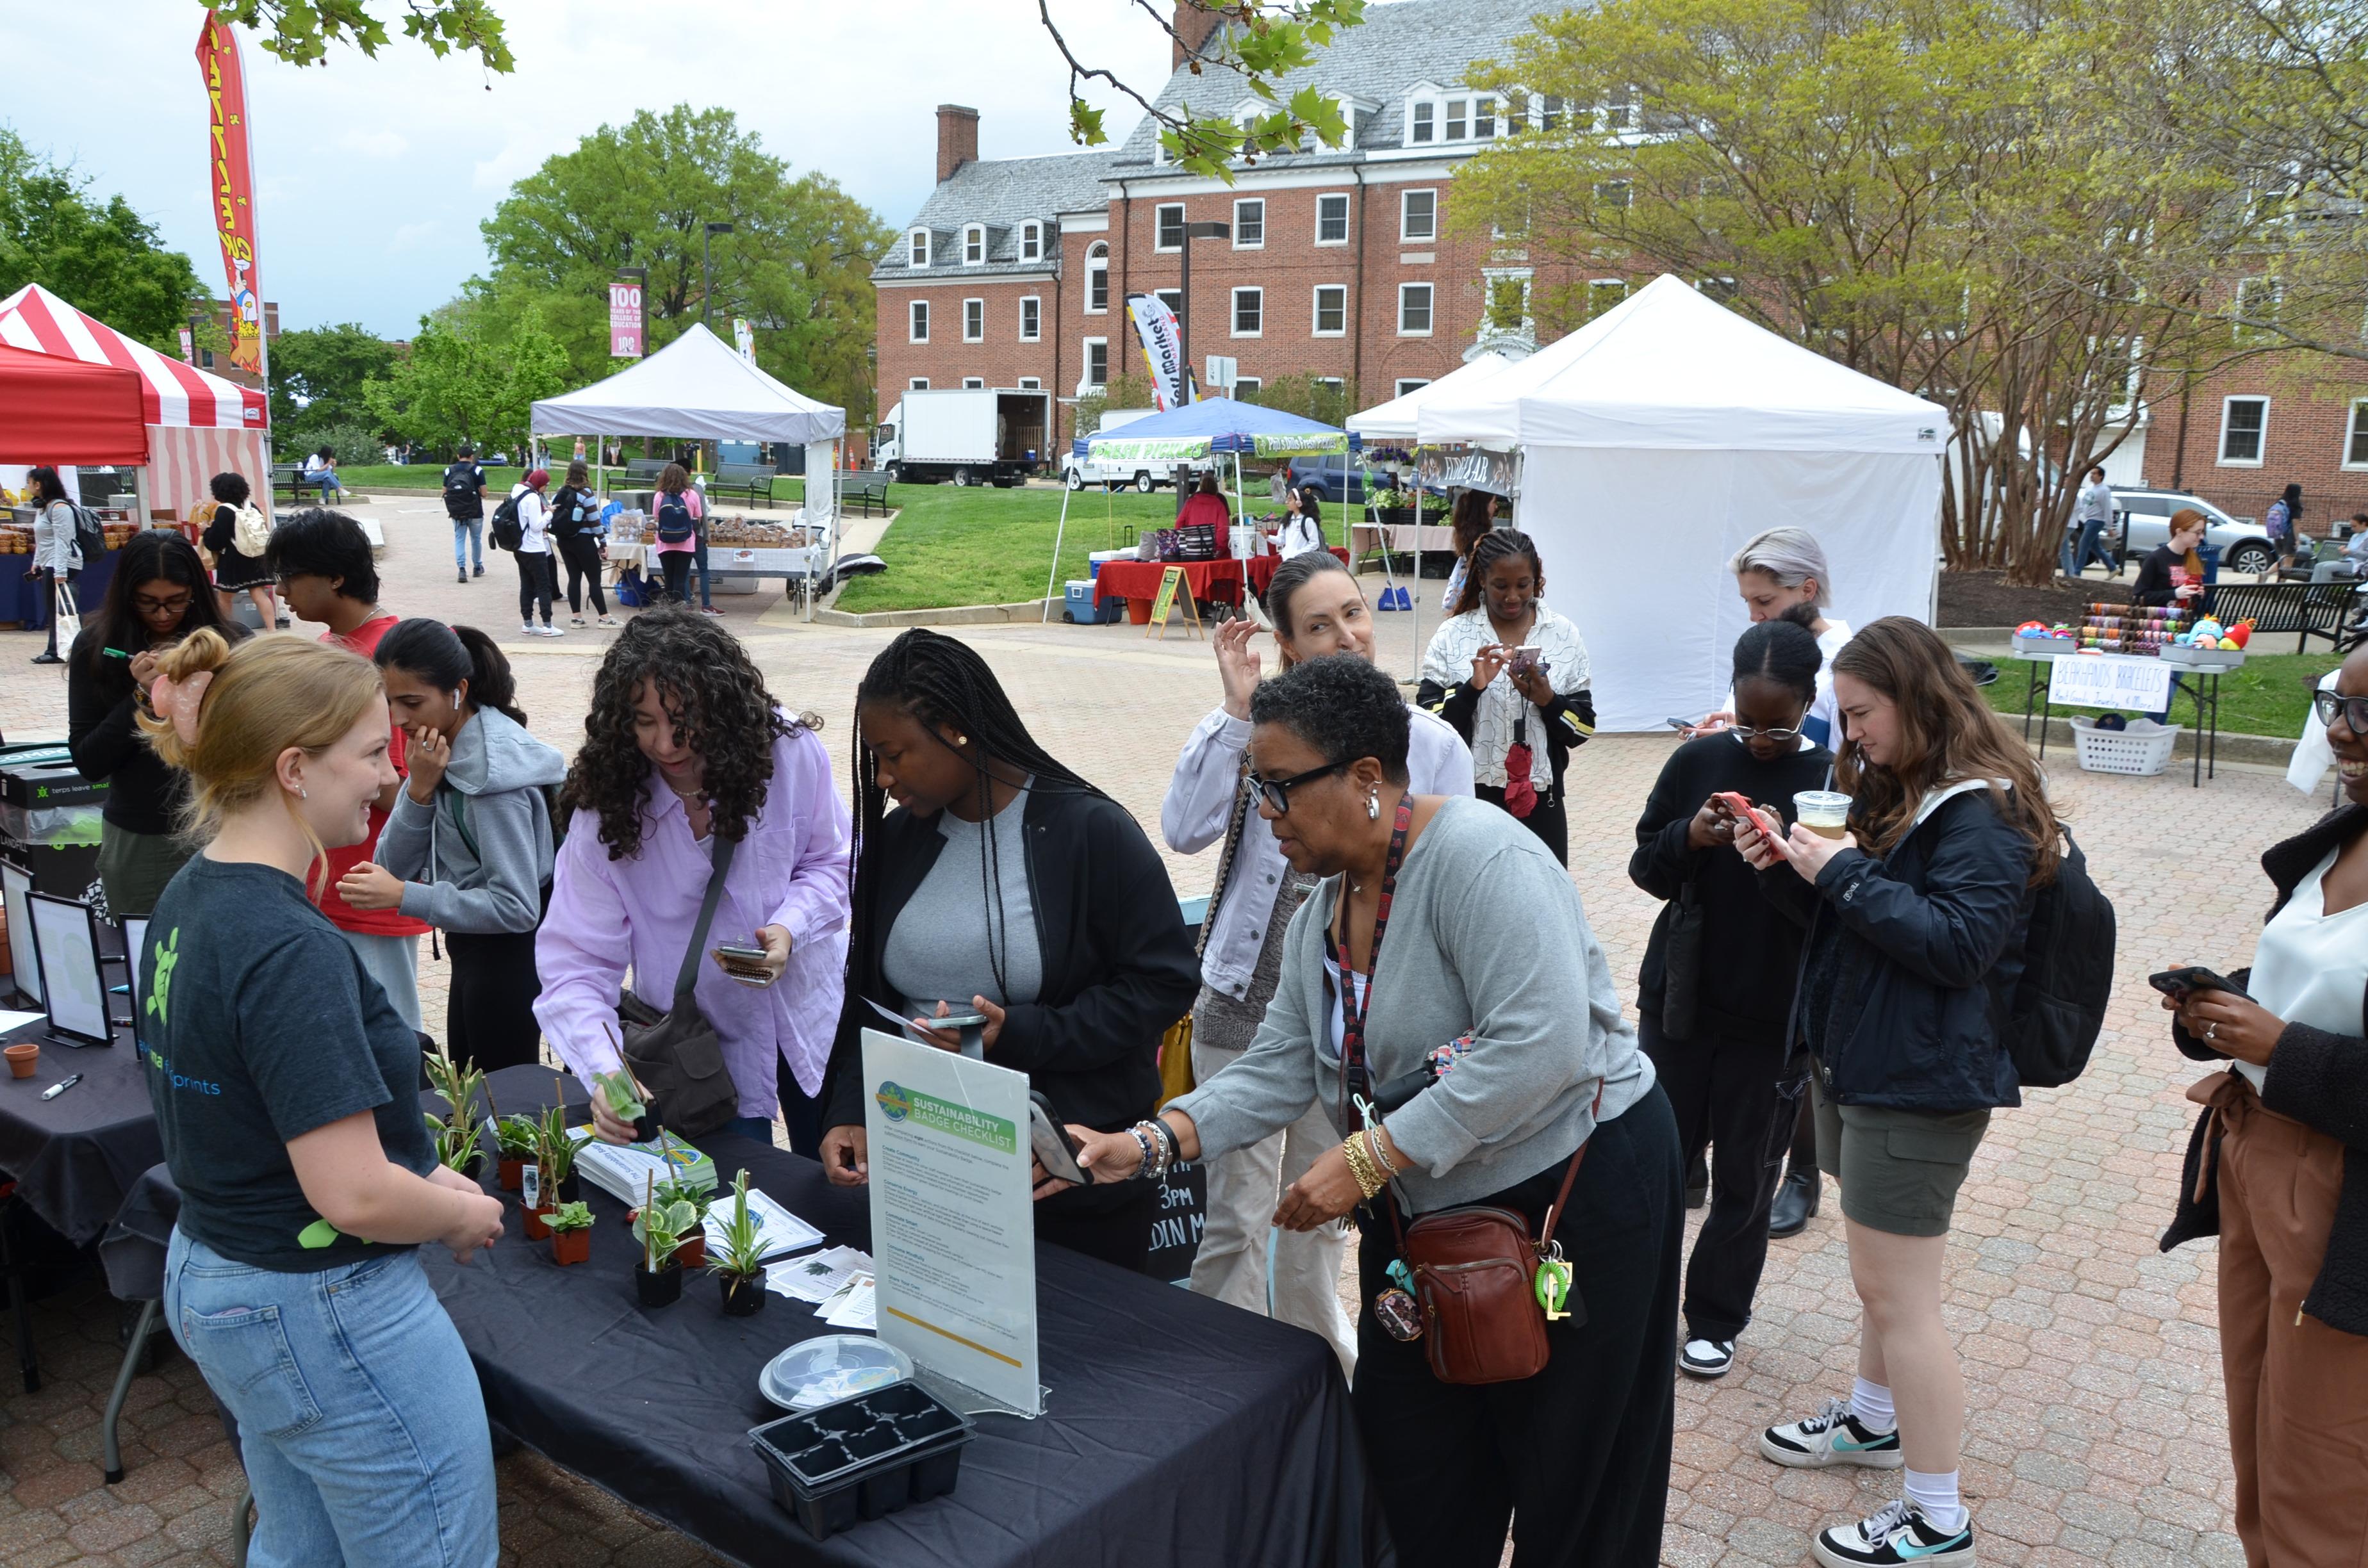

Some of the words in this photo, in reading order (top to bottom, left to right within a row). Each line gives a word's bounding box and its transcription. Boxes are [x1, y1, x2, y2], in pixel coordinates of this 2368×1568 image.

[609, 287, 641, 307] 100
[1160, 316, 1178, 359] MARYLAND
[1092, 441, 1140, 459] FRESH
[1142, 441, 1205, 460] PICKLES
[1297, 436, 1317, 450] Fresh
[1317, 436, 1336, 451] Pickles
[2057, 661, 2112, 688] BEARHANDS
[2116, 664, 2166, 693] BRACELETS
[2132, 696, 2158, 710] More!
[913, 1096, 999, 1134] SUSTAINABILITY
[914, 1107, 950, 1129] BADGE
[952, 1120, 1012, 1149] CHECKLIST
[882, 1144, 895, 1154] Create
[896, 1149, 920, 1163] Community
[883, 1178, 903, 1191] Conserve
[903, 1186, 917, 1196] Energy
[1158, 1184, 1194, 1209] 3PM
[885, 1211, 904, 1223] Commute
[905, 1218, 918, 1228] Smart
[886, 1242, 905, 1254] Consume
[905, 1250, 925, 1262] Mindfully
[887, 1273, 900, 1283] Share
[900, 1278, 910, 1287] Your
[910, 1282, 920, 1292] Own
